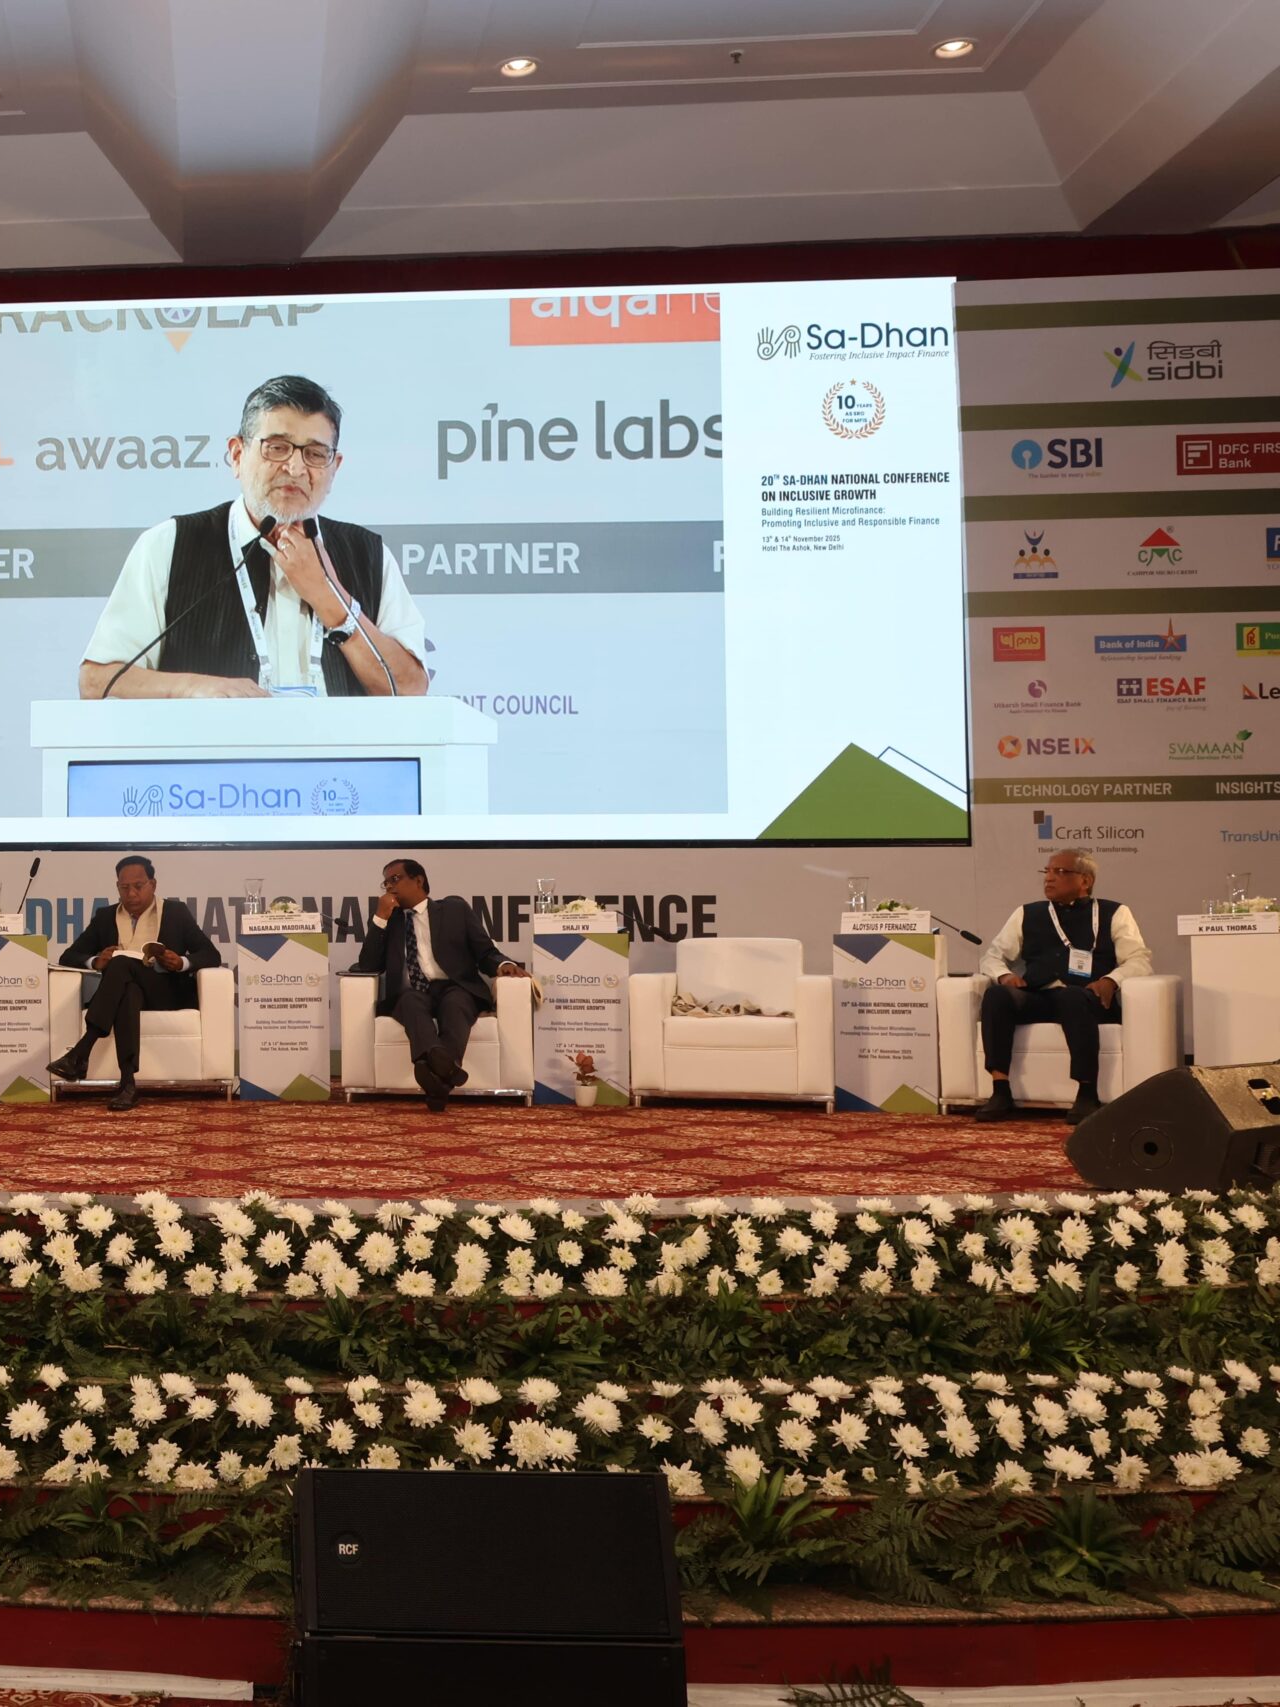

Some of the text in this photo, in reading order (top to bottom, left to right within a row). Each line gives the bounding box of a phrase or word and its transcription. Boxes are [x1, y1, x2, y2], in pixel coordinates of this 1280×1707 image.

[807, 323, 948, 349] Sa-Dhan
[1147, 340, 1222, 359] सिडबी
[809, 353, 847, 361] Fostering
[886, 351, 915, 360] Impact
[1148, 360, 1222, 380] sidbi
[837, 395, 855, 410] 10
[438, 403, 578, 480] pine
[1048, 438, 1103, 469] SBI
[1219, 458, 1251, 468] Bank
[783, 475, 827, 485] SA-DHAN
[831, 474, 880, 484] NATIONAL
[884, 472, 949, 483] CONFERENCE
[762, 490, 876, 501] ON INCLUSIVE GROWTH
[762, 508, 793, 517] Building
[796, 507, 829, 515] Resilient
[762, 520, 801, 528] Promoting
[842, 518, 856, 526] and
[858, 518, 906, 526] Responsible
[909, 517, 939, 525] Finance
[403, 542, 580, 575] PARTNER
[1125, 640, 1136, 648] of
[1137, 640, 1161, 648] India
[1147, 677, 1206, 696] ESAF
[1027, 738, 1095, 755] NSE IX
[1169, 742, 1246, 754] SVAMAAN
[322, 790, 336, 801] 10
[1004, 783, 1171, 796] TECHNOLOGY PARTNER
[169, 783, 301, 811] Sa-Dhan
[1055, 826, 1144, 839] Craft Silicon
[885, 923, 916, 931] FERNANDEZ
[261, 974, 302, 983] Sa-Dhan
[557, 975, 600, 983] Sa-Dhan
[857, 978, 906, 986] Sa-Dhan
[339, 1544, 358, 1554] RCF
